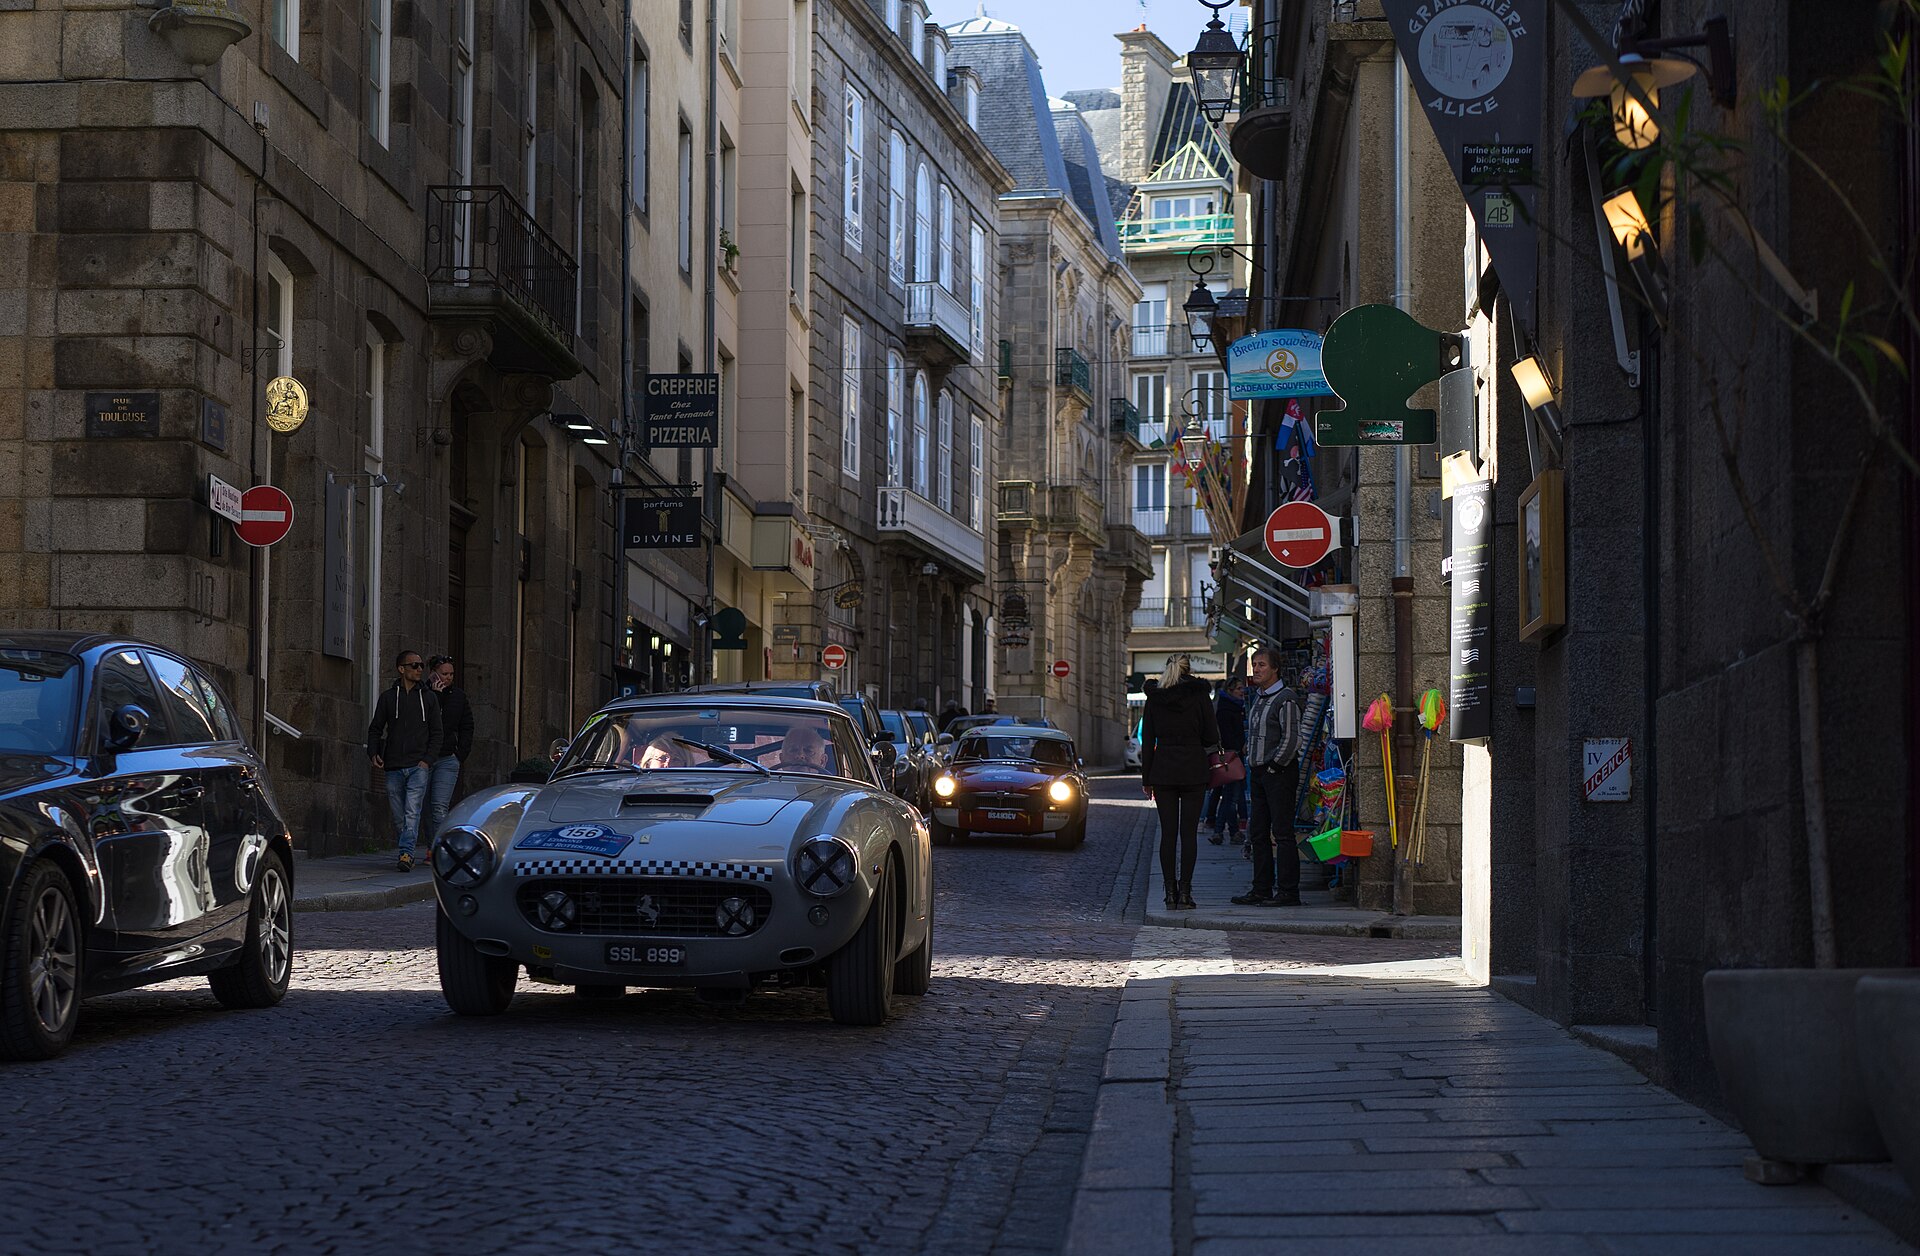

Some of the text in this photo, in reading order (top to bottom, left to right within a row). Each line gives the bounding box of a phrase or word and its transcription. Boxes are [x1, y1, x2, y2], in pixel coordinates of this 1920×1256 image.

[1408, 0, 1468, 34] GRA
[1427, 97, 1499, 117] ALICE
[1463, 146, 1488, 154] Farine
[1470, 165, 1482, 173] du
[1487, 207, 1508, 222] AB
[648, 379, 717, 396] CREPERIE
[670, 401, 692, 409] Chez
[98, 412, 147, 423] TOULOUSE
[649, 410, 715, 422] Tante Fernande
[650, 426, 712, 444] PIZZERIA
[643, 500, 684, 509] parfums
[632, 534, 695, 544] DIVINE
[623, 687, 633, 697] P
[1588, 752, 1603, 765] IV
[1585, 743, 1630, 796] LICENCE
[566, 828, 599, 838] 156
[555, 842, 608, 853] ROTHSCHILD
[609, 946, 680, 963] SSL 899
